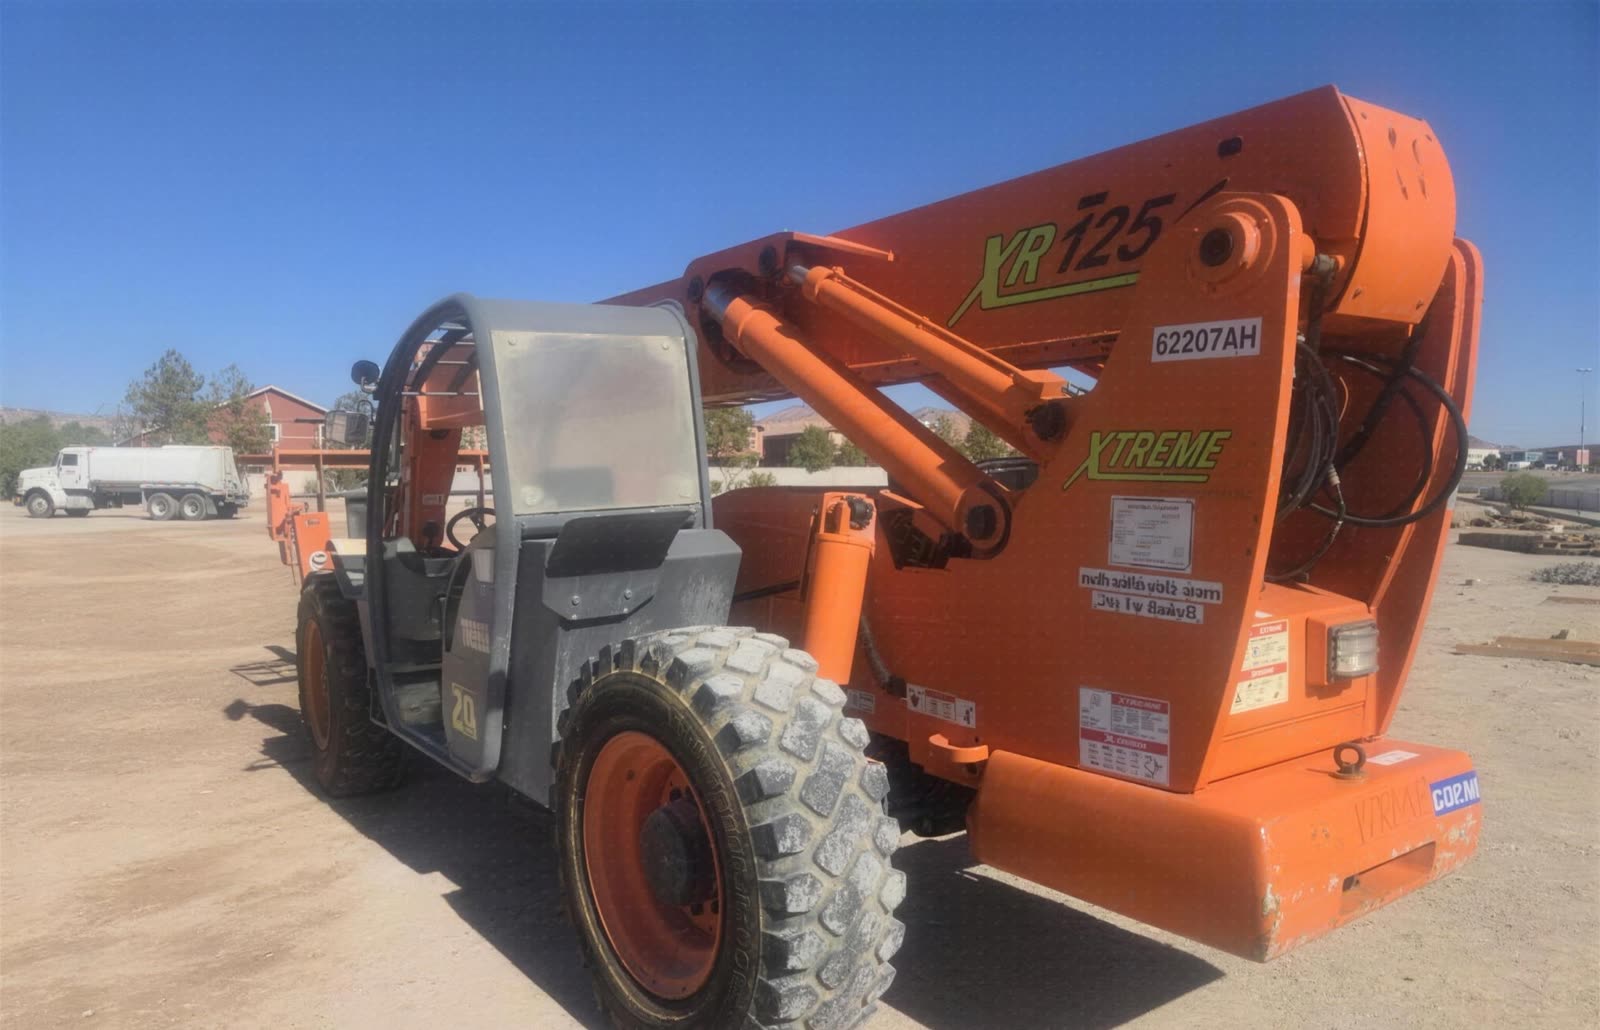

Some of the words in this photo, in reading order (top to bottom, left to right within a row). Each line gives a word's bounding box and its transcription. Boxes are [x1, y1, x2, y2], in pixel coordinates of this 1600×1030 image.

[947, 222, 1058, 328] XR
[1056, 191, 1177, 274] 125
[1155, 324, 1258, 356] 62207AH
[1063, 429, 1233, 491] XTREME
